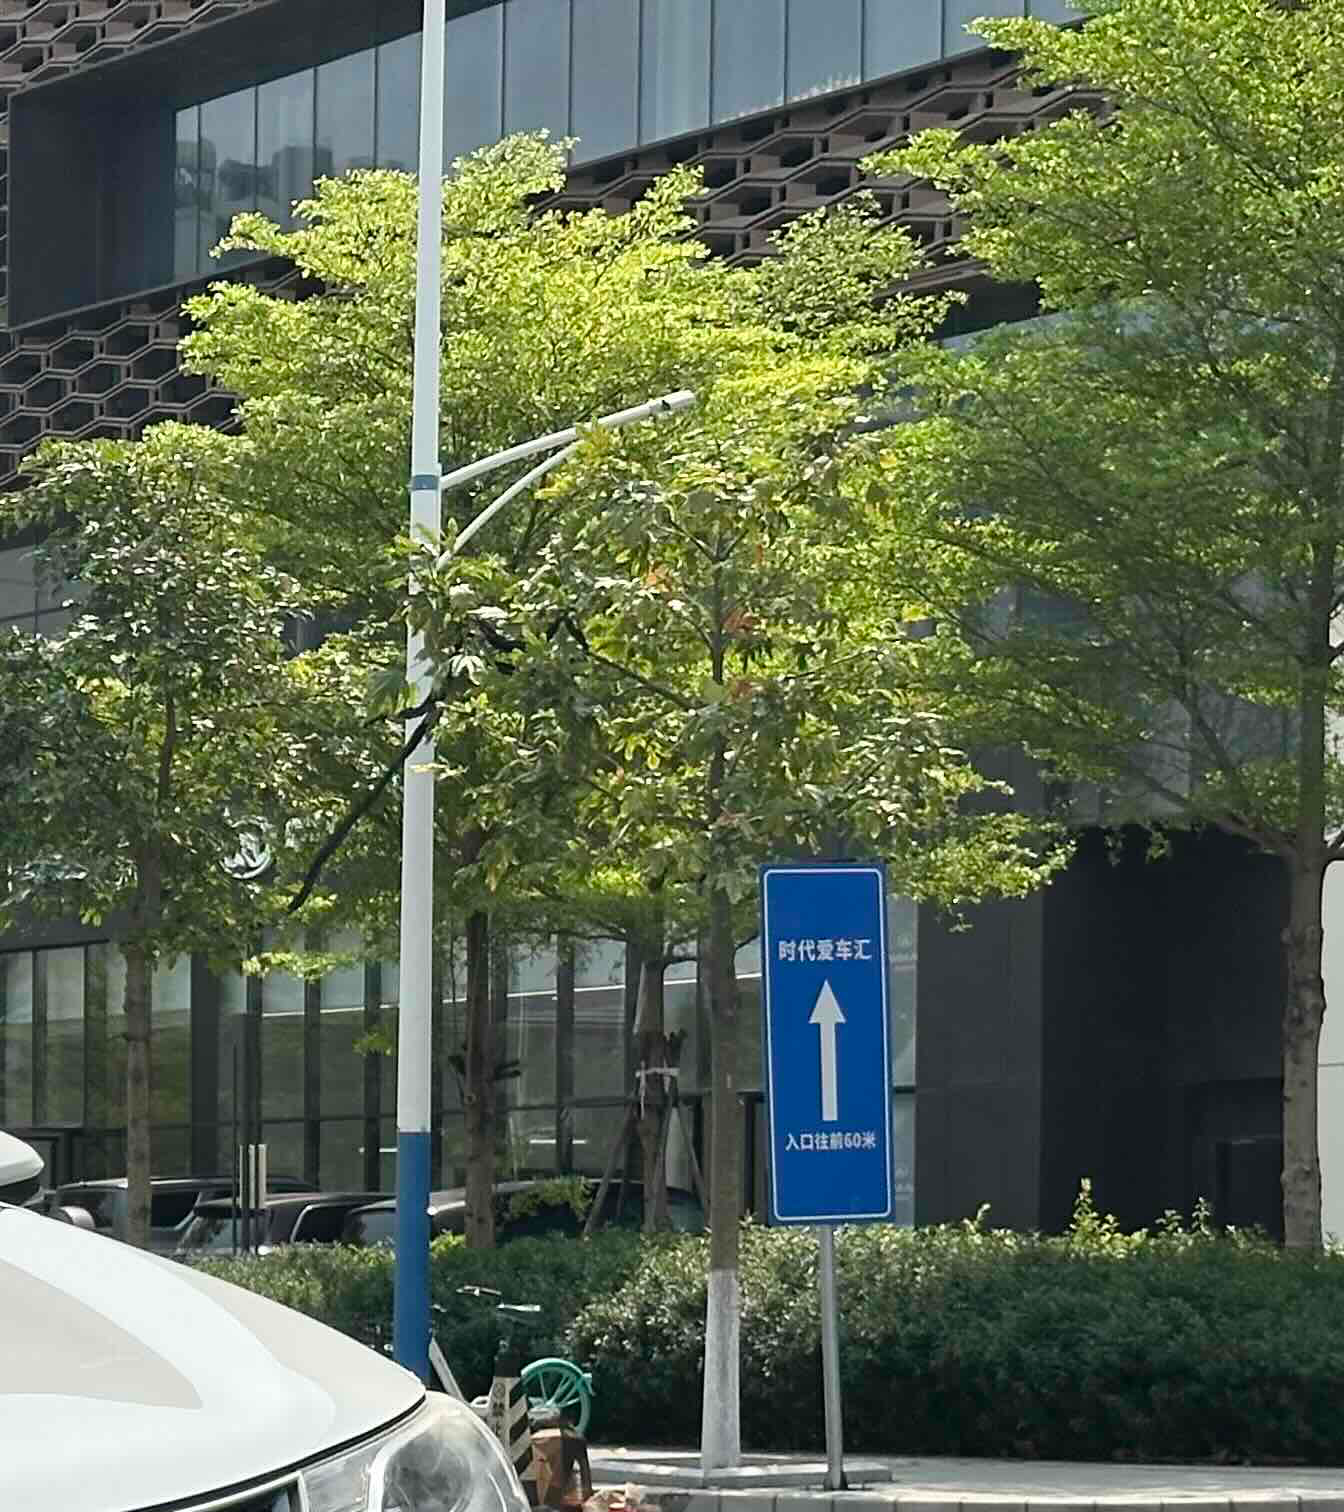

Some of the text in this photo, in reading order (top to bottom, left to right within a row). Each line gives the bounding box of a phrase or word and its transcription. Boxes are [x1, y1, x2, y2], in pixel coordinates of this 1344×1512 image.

[778, 938, 873, 962] 时代爱车汇
